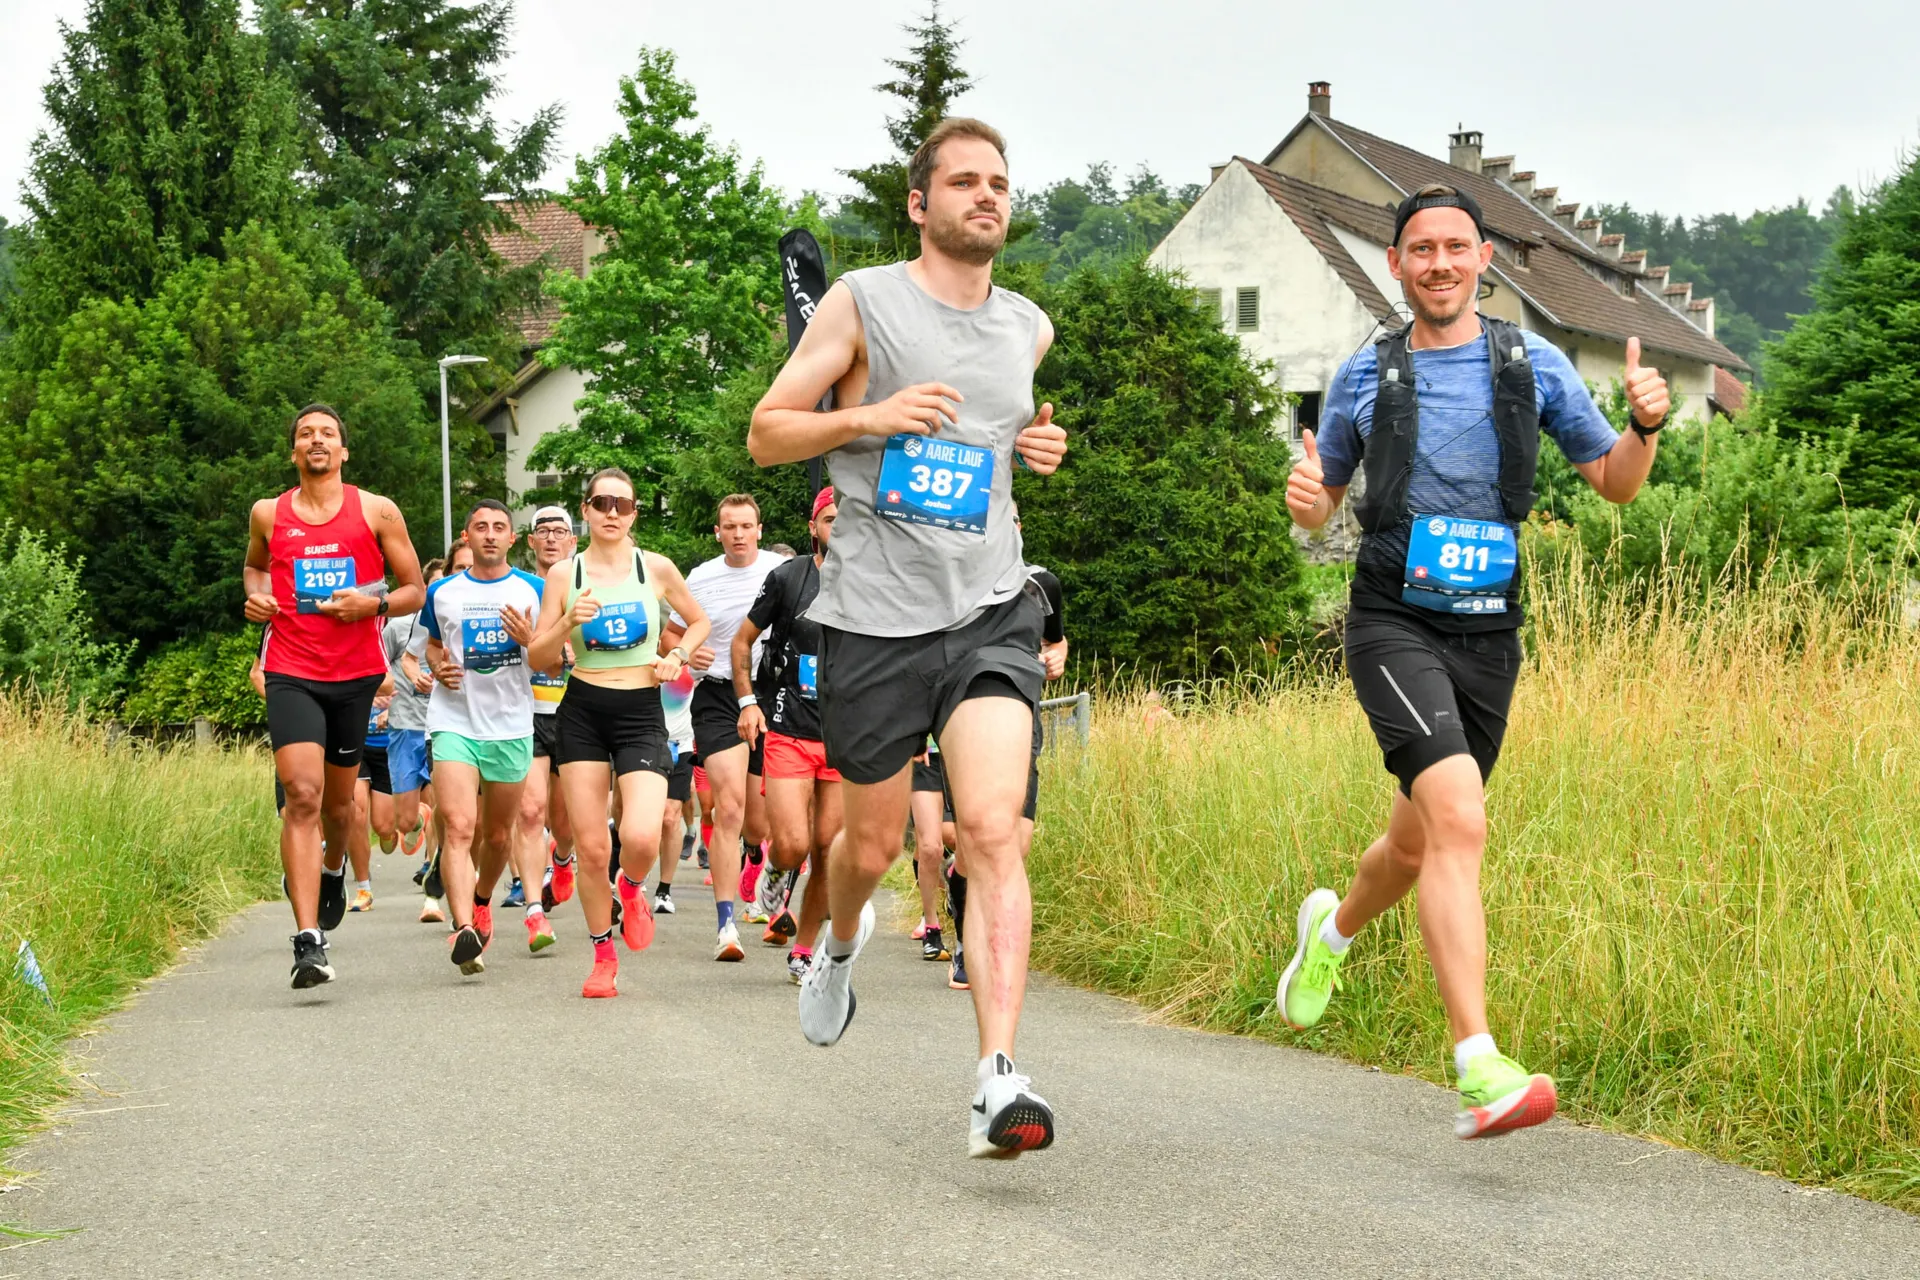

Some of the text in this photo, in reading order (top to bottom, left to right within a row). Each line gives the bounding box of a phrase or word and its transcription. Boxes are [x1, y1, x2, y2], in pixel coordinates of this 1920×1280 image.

[926, 443, 984, 468] AARE LAUF
[909, 464, 973, 499] 387
[1449, 522, 1505, 541] AARE LAUF
[304, 543, 339, 555] SUISSE
[1439, 542, 1489, 572] 811
[332, 559, 347, 569] LAUF
[304, 571, 347, 588] 2197
[1485, 599, 1504, 610] 811
[604, 617, 628, 636] 13
[475, 630, 509, 645] 489
